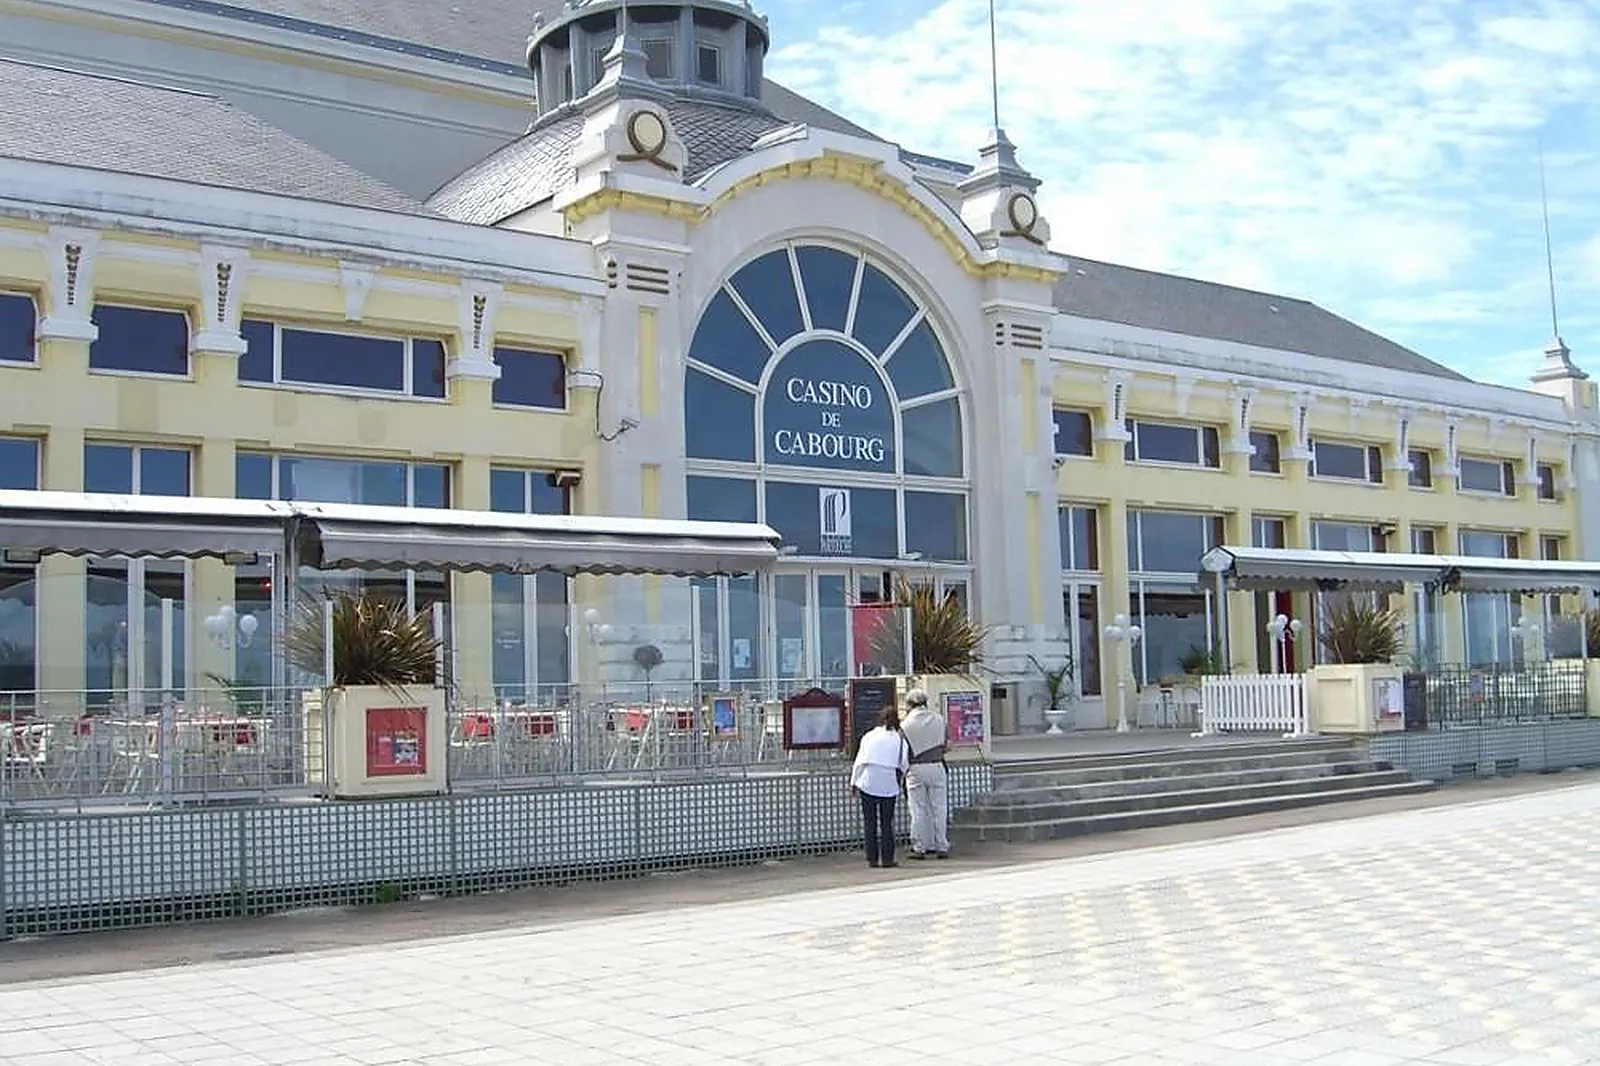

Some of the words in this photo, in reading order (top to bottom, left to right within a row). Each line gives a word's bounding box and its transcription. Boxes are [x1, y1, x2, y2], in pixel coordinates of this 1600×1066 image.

[787, 378, 872, 409] CASINO
[822, 412, 841, 428] DE
[774, 430, 884, 462] CABOURG
